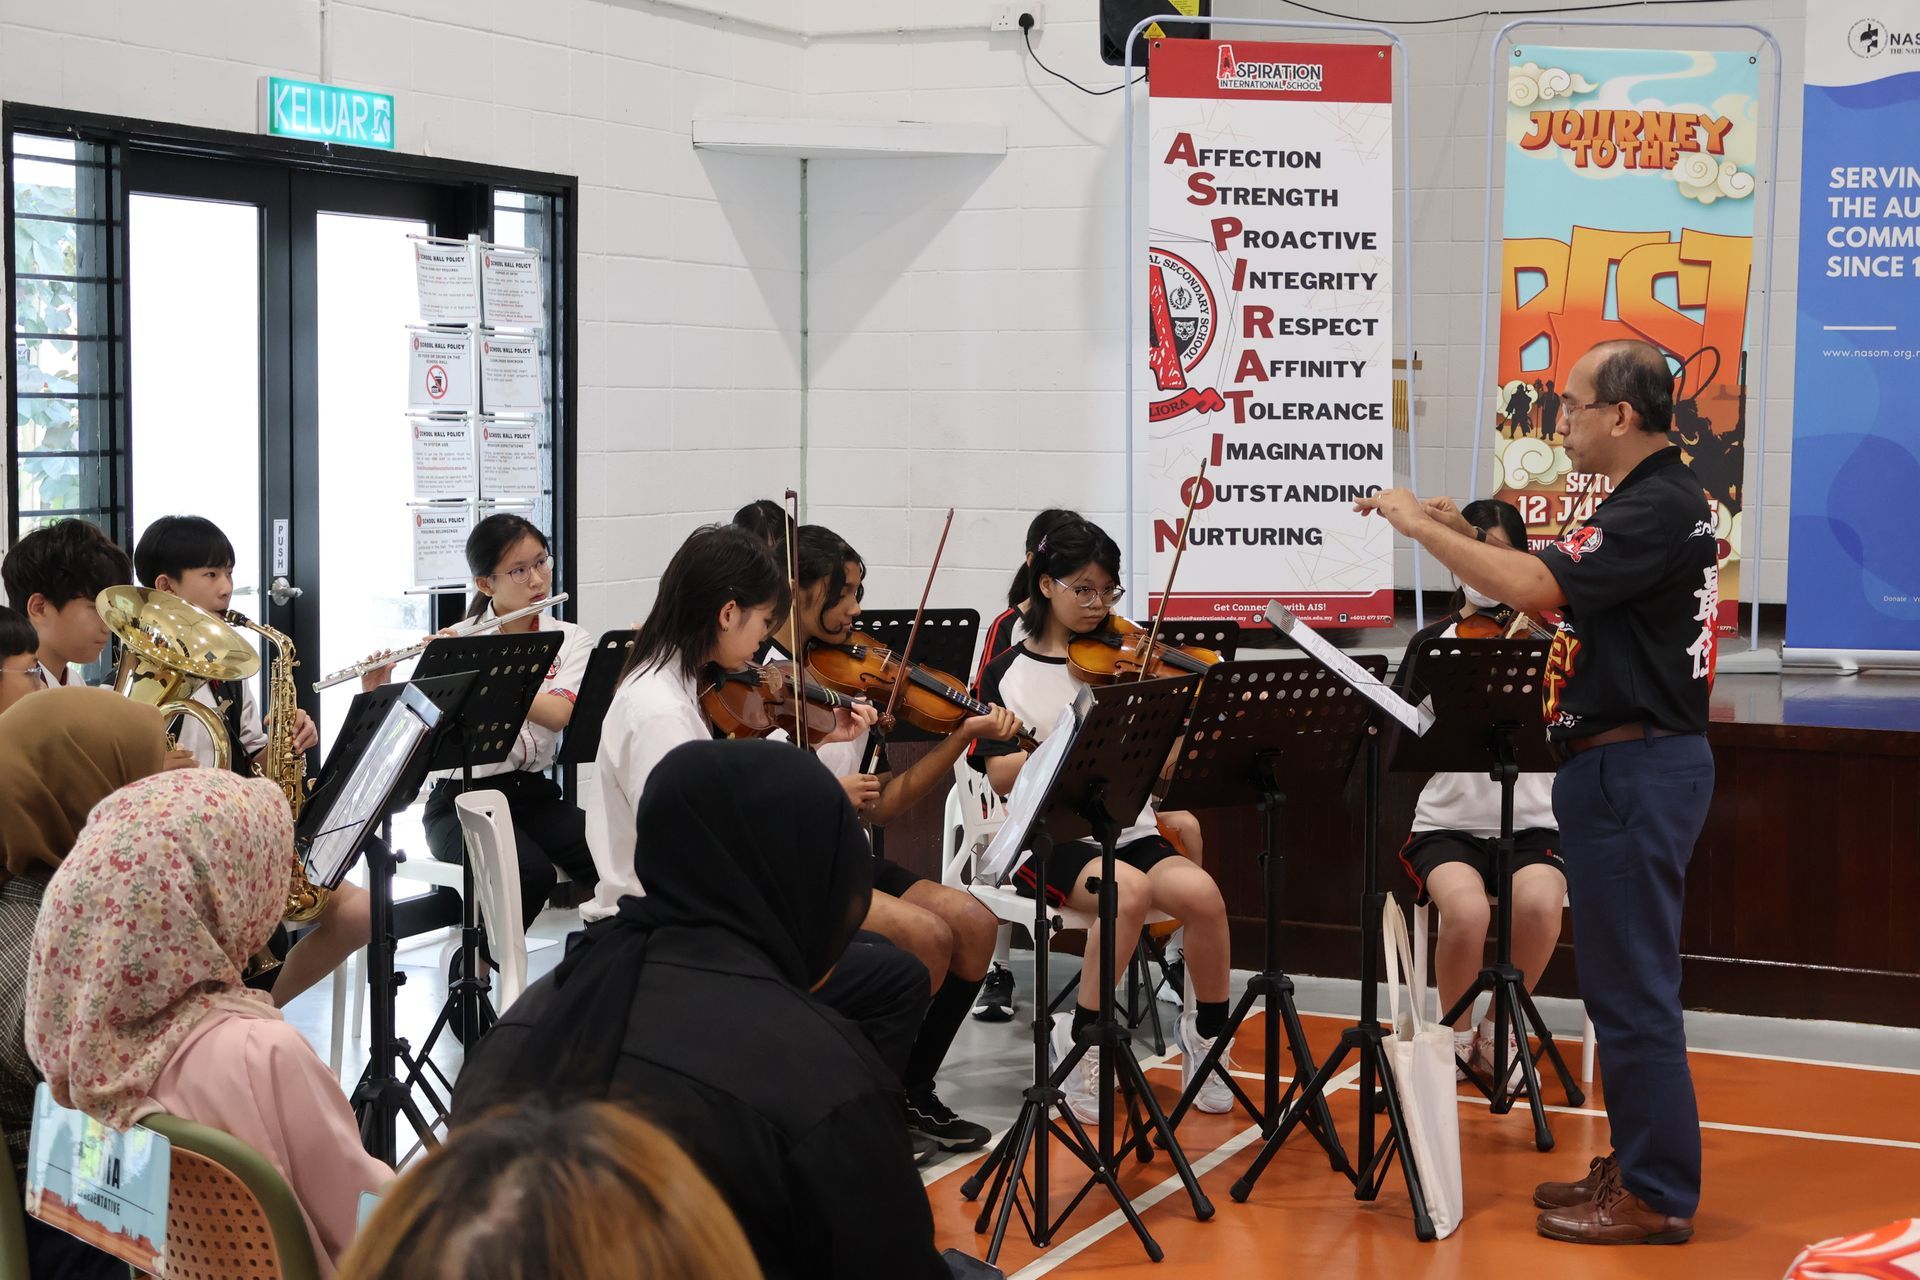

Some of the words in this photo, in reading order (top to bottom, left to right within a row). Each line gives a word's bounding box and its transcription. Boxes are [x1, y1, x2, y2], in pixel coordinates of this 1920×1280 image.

[1218, 45, 1321, 80] ASPIRATION
[1220, 79, 1284, 90] INTERNATIONAL
[1286, 81, 1321, 91] SCHOOL
[273, 82, 369, 141] KELUAR
[1520, 109, 1733, 154] JOURNEY
[1163, 132, 1322, 169] AFFECTION
[1570, 139, 1617, 169] TO
[1619, 140, 1680, 170] THE
[1186, 171, 1339, 207] STRENGTH
[1827, 196, 1877, 218] THE
[1210, 216, 1377, 252] PROACTIVE
[1827, 226, 1920, 248] COMM
[1232, 258, 1378, 292] INTEGRITY
[1825, 255, 1904, 278] SINCE
[1162, 257, 1210, 316] SECONDARY
[1242, 304, 1379, 339] RESPECT
[1184, 317, 1210, 362] SCHOOL
[1233, 349, 1367, 384] AFFINITY
[1222, 389, 1384, 424] TOLERANCE
[1209, 433, 1384, 467] IMAGINATION
[1565, 471, 1615, 493] SATU
[422, 517, 436, 525] SCHOOL
[1517, 495, 1548, 524] 12
[1153, 518, 1323, 553] NURTURING
[1213, 603, 1230, 612] Get
[1232, 603, 1268, 612] Connec
[1283, 602, 1306, 611] with
[1307, 603, 1327, 611] AIS!
